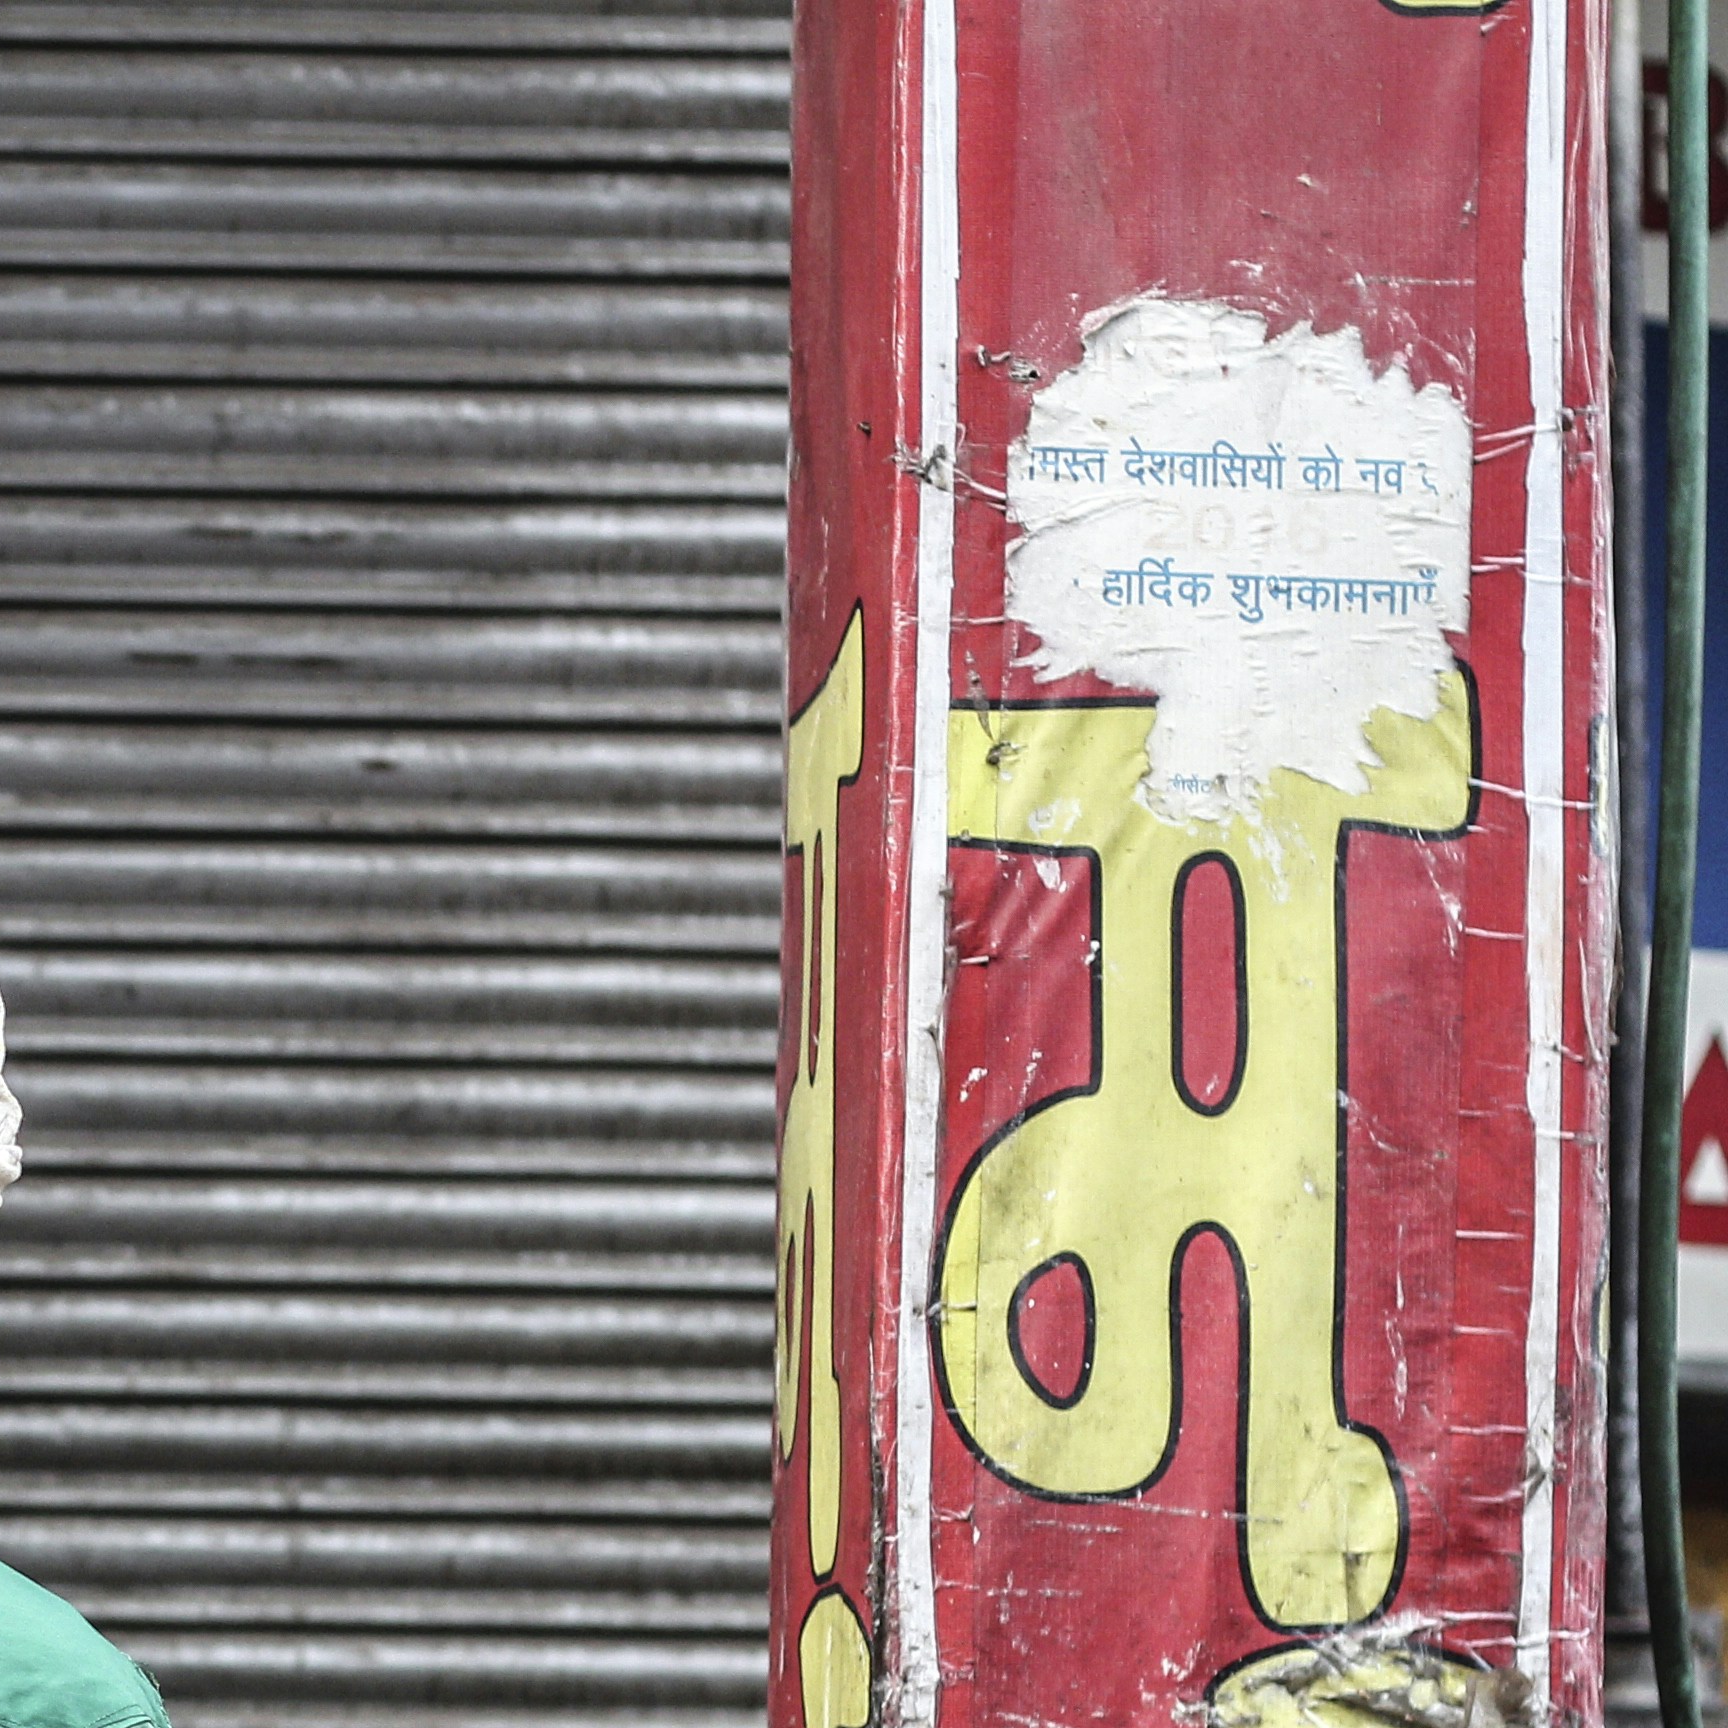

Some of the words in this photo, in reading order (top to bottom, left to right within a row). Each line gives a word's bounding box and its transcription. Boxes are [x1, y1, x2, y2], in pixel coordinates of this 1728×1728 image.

[1121, 437, 1286, 489] देशवासियों
[1299, 444, 1343, 492] को
[1356, 458, 1406, 493] नव
[1103, 557, 1214, 606] हार्दिक
